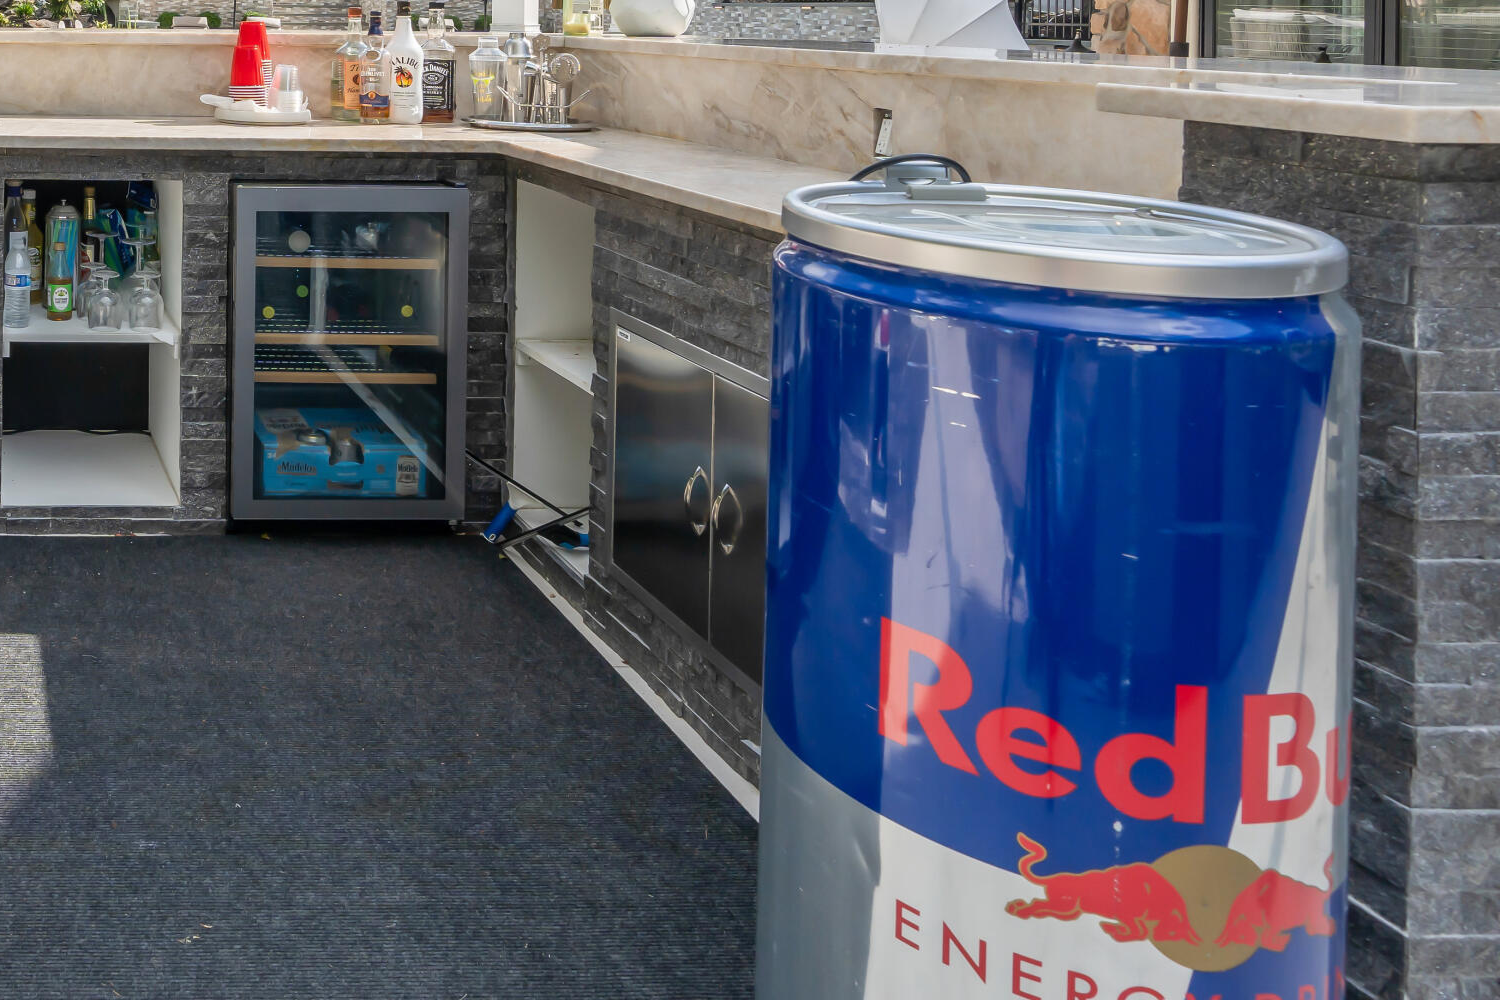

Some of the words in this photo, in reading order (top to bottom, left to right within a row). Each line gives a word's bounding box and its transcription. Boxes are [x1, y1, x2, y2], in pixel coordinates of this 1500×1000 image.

[878, 616, 1208, 825] Red
[1241, 692, 1352, 825] Bu
[895, 899, 1221, 1000] ENER
